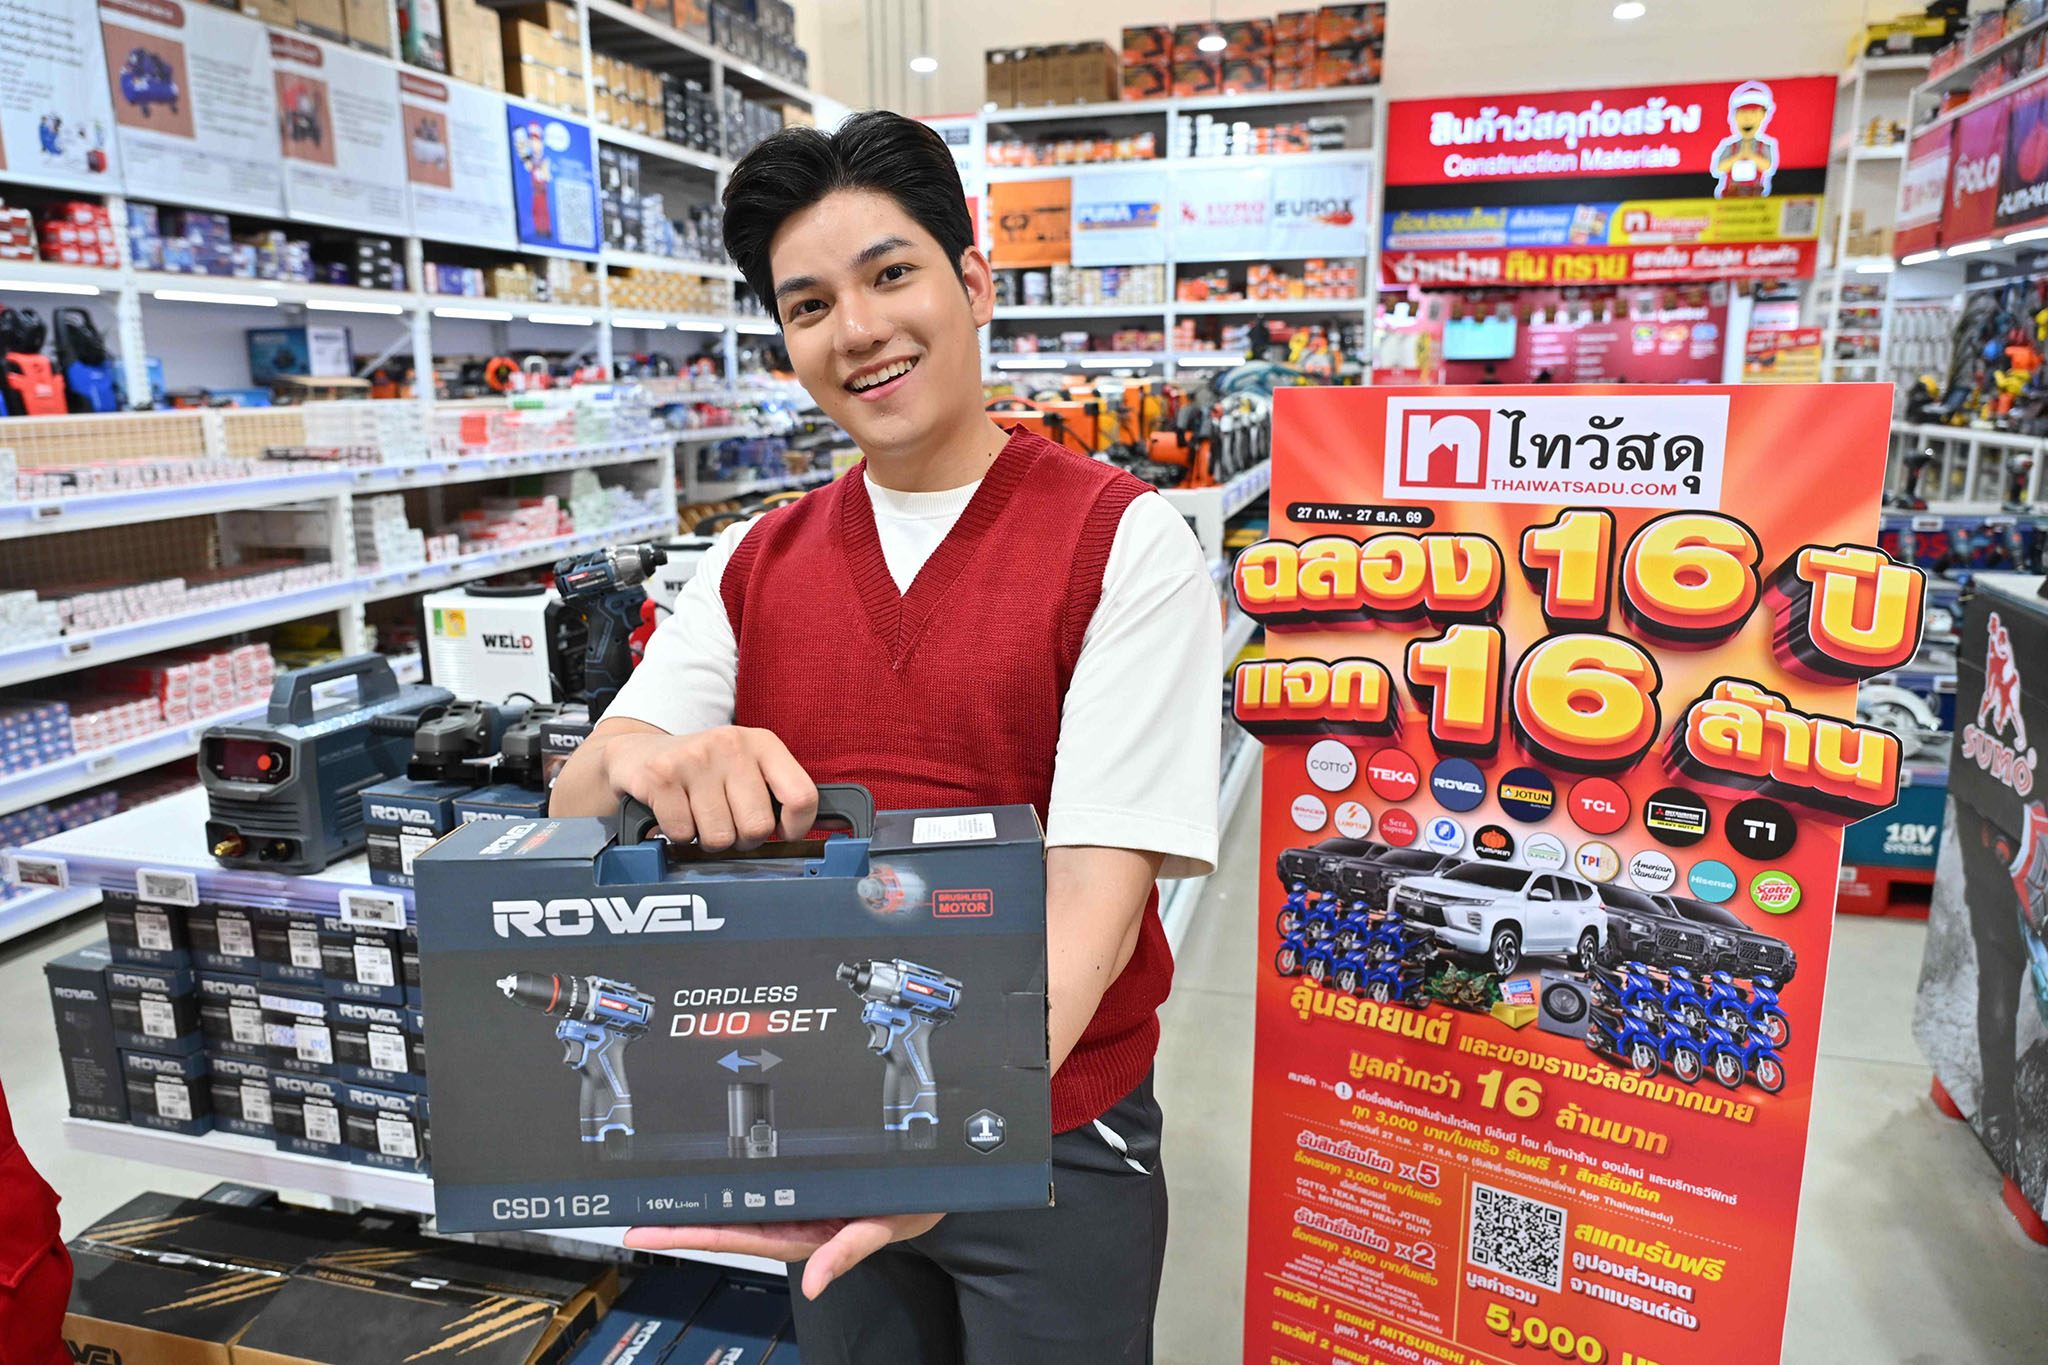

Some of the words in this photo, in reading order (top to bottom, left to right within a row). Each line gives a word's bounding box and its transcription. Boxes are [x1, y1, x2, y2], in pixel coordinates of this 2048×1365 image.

[1429, 97, 1702, 149] สินค้าวัสดุก่อสร้าง
[1443, 150, 1579, 178] Construction
[1580, 144, 1681, 173] Materials
[1497, 409, 1705, 494] ไทวัสดุ
[1491, 479, 1677, 496] THAIWATSADU.COM
[1297, 507, 1312, 519] 27
[1316, 508, 1342, 520] ก.พ.
[1357, 510, 1371, 521] 27
[1376, 509, 1401, 523] ส.ค.
[1406, 511, 1422, 523] 69
[1237, 533, 1500, 618] ฉลอง
[1526, 508, 1756, 632] 16
[1795, 546, 1920, 665] ปี
[1238, 660, 1390, 725] แจก
[1411, 624, 1655, 757] 16
[1685, 678, 1897, 805] ล้าน
[1310, 759, 1350, 774] COTTO
[1962, 724, 2034, 797] SUMO
[1368, 767, 1416, 785] TEKA
[1433, 777, 1483, 794] ROWEL
[1513, 788, 1550, 803] JOTUN
[1581, 798, 1616, 814] TCL
[370, 805, 435, 825] ROWEL
[1388, 818, 1407, 828] Sera
[402, 826, 432, 836] ROWEL
[1743, 819, 1777, 842] T1
[1886, 823, 1936, 844] 18V
[1476, 846, 1511, 857] PUMPKIN
[1884, 842, 1934, 857] SYSTEM
[1630, 868, 1669, 882] Standard
[1633, 859, 1673, 874] American
[1691, 875, 1733, 889] Hisense
[938, 893, 989, 902] BRUSHLESS
[939, 902, 987, 913] MOTOR
[1759, 892, 1790, 902] Brite
[492, 894, 726, 938] ROWEL
[113, 973, 170, 991] ROWEL
[202, 980, 258, 998] ROWEL
[54, 987, 98, 1000] ROWEL
[673, 986, 799, 1007] CORDLESS
[339, 1003, 402, 1023] ROWEL
[670, 1011, 751, 1037] DUO
[767, 1008, 838, 1033] SET
[1290, 978, 1453, 1045] ลุ้นรถยนต์
[1458, 1035, 1756, 1123] และของรางวัลอีกมากมาย
[128, 1056, 186, 1074] ROWEL
[276, 1077, 335, 1097] ROWEL
[349, 1089, 411, 1111] ROWEL
[1350, 1051, 1462, 1099] มูลค่ากว่า
[1478, 1069, 1542, 1117] 16
[1556, 1102, 1669, 1155] ล้านบาท
[979, 1115, 993, 1136] 1
[1297, 1130, 1393, 1174] รับสิทธิ์ชิงโชค
[1398, 1160, 1440, 1188] x5
[1352, 1105, 1370, 1120] ทุก
[1375, 1111, 1418, 1132] 3,000
[1424, 1126, 1499, 1156] บาท/ใบเสร็จ
[1505, 1147, 1550, 1171] รับฟรี
[1559, 1164, 1568, 1176] 1
[1576, 1167, 1661, 1204] สิทธิ์ชิงโชค
[1544, 1140, 1597, 1167] ทั้งหน้าร้าน
[1601, 1160, 1644, 1180] ออนไลน์
[1345, 1167, 1379, 1186] 3,000
[1383, 1180, 1442, 1206] บาท/ใบเสร็จ
[1382, 1130, 1393, 1139] 27
[1423, 1143, 1434, 1152] 27
[1579, 1189, 1600, 1203] App
[1604, 1196, 1674, 1225] Thaiwatsadu)
[492, 1194, 610, 1220] CSD162
[646, 1198, 674, 1210] 16V
[1296, 1177, 1327, 1193] COTTO,
[1331, 1187, 1356, 1202] TEKA,
[1360, 1196, 1394, 1215] ROWEL,
[1400, 1210, 1433, 1228] JOTUN,
[1296, 1186, 1315, 1200] TCL,
[1318, 1193, 1370, 1216] MITSUBISHI
[1373, 1212, 1403, 1228] HEAVY
[1406, 1223, 1431, 1237] DUTY
[1294, 1206, 1390, 1253] รับสิทธิ์ชิงโชค
[1394, 1242, 1436, 1270] x2
[1343, 1246, 1375, 1265] 3,000
[1574, 1223, 1726, 1281] สแกนรับฟรี
[1572, 1250, 1692, 1300] คูปองส่วนลด
[1466, 1270, 1537, 1306] มูลค่ารวม
[1570, 1276, 1697, 1329] จากแบรนด์ดัง
[1272, 1320, 1317, 1344] รางวัลที่
[1320, 1338, 1330, 1350] 2
[1273, 1286, 1318, 1309] รางวัลที่
[1323, 1304, 1329, 1314] 1
[1335, 1308, 1375, 1332] รถยนต์
[1380, 1324, 1465, 1364] MITSUBISHI
[1485, 1302, 1603, 1363] 5,000
[1363, 1334, 1420, 1362] 1,404,000
